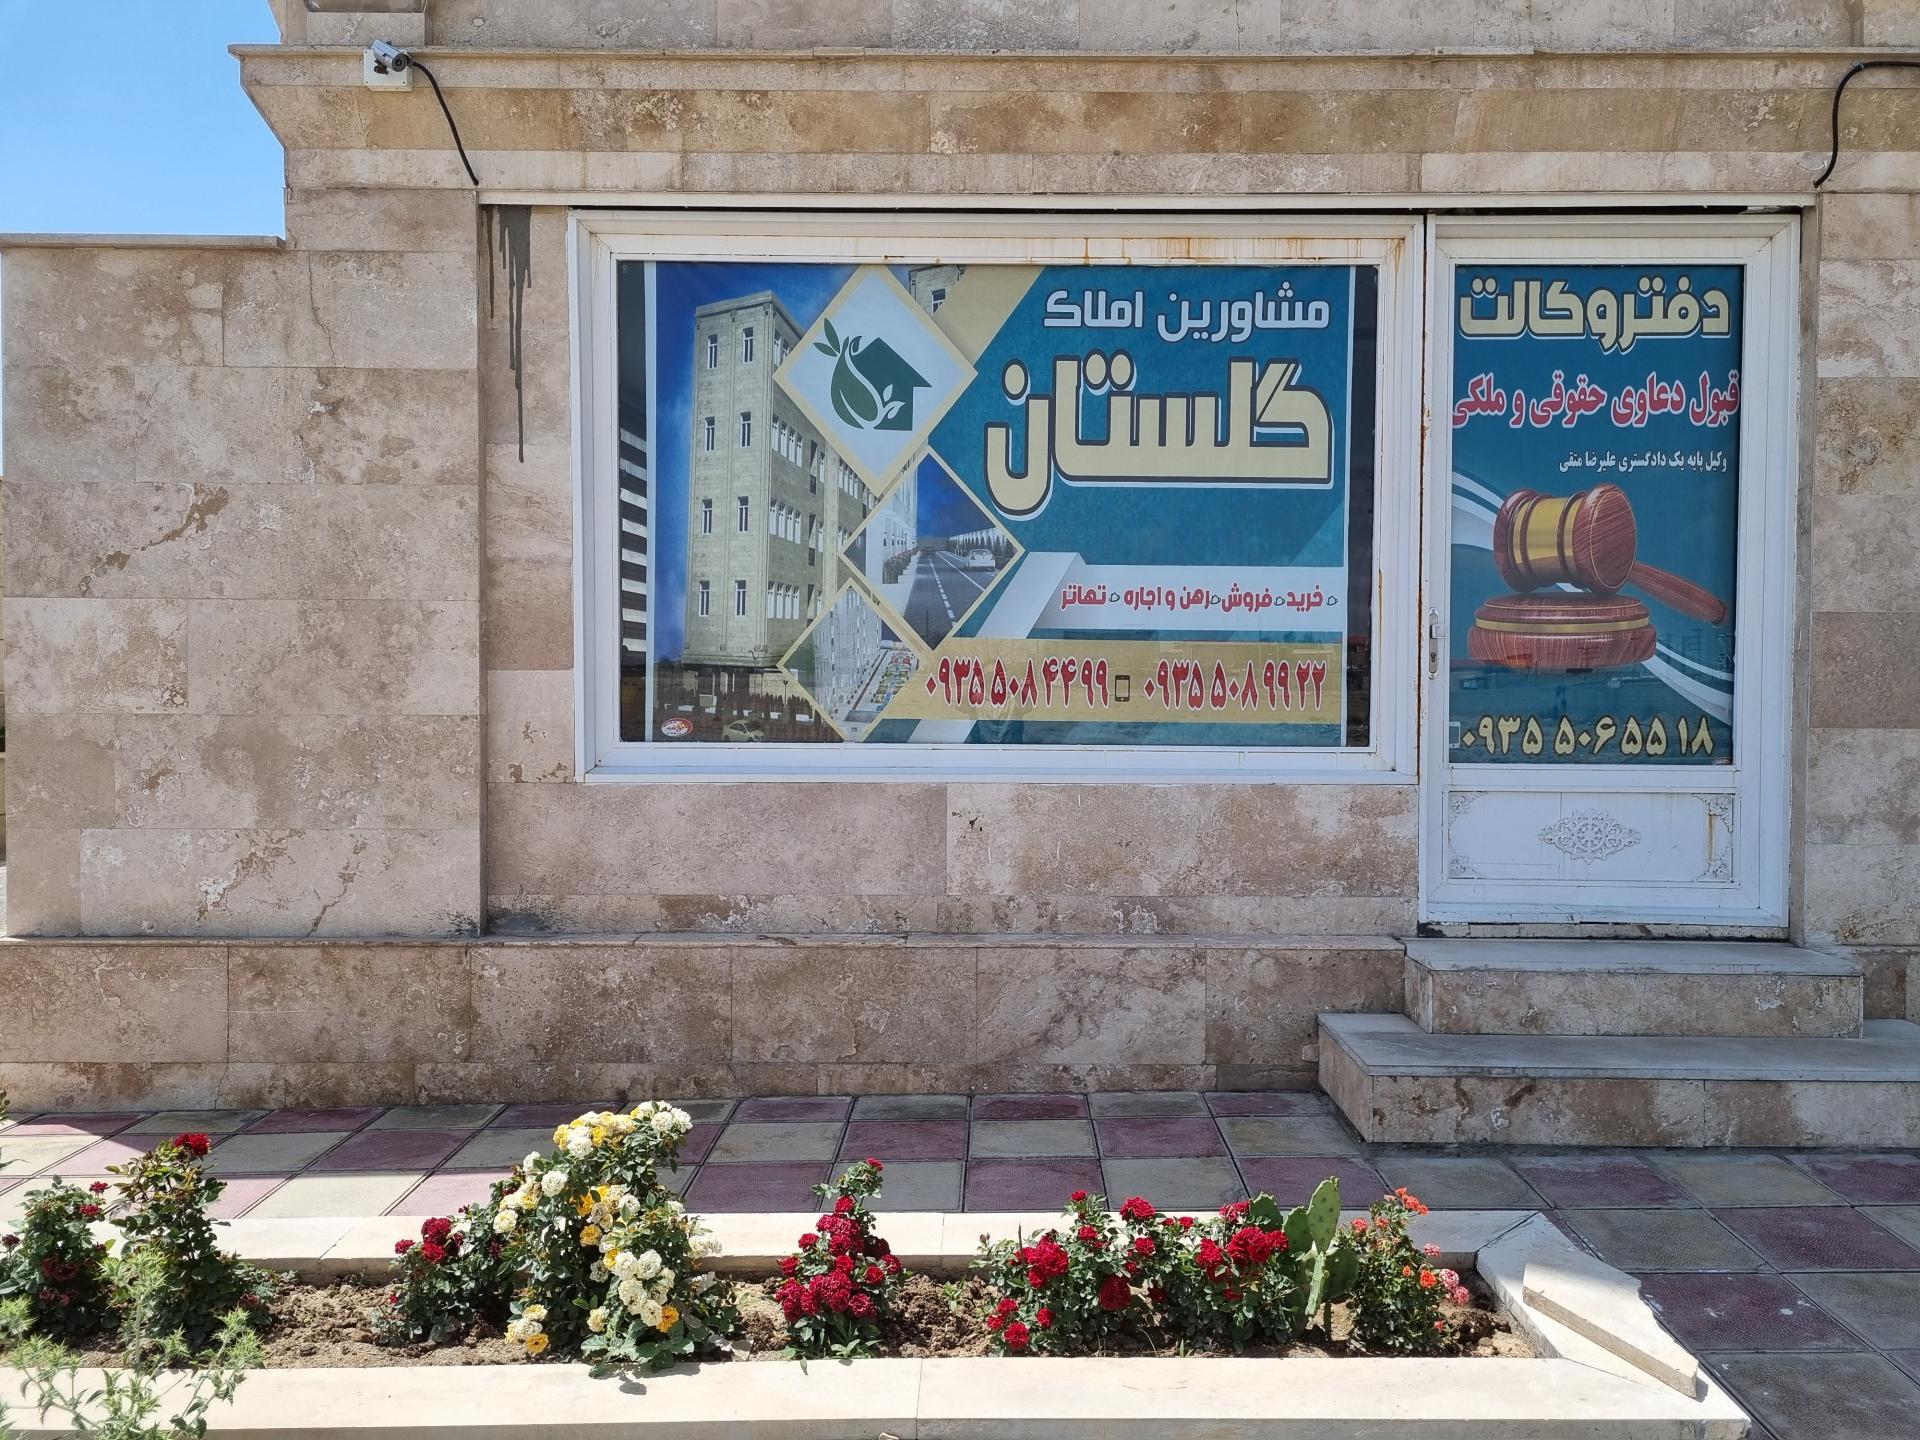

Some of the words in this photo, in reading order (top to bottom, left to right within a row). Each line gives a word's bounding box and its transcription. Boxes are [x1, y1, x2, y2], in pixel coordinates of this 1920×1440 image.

[1043, 289, 1144, 328] املاک
[1156, 280, 1331, 343] مشاورین
[1452, 371, 1507, 428] ملکی
[1509, 389, 1526, 428] و
[1529, 369, 1608, 428] حقوقی
[1611, 371, 1686, 428] دعاوی
[1689, 369, 1740, 427] قبول
[984, 348, 1335, 521] گلستان
[1585, 450, 1616, 473] علیرضا
[1618, 450, 1666, 473] دادگستری
[1668, 450, 1685, 471] یک
[1687, 450, 1704, 473] پایه
[1705, 450, 1727, 473] وکیل
[1060, 584, 1107, 611] تهاتر
[1123, 586, 1161, 612] اجاره
[1165, 589, 1176, 611] و
[1179, 585, 1211, 611] رهن
[1221, 582, 1272, 613] فروش
[1286, 584, 1323, 612] خرید
